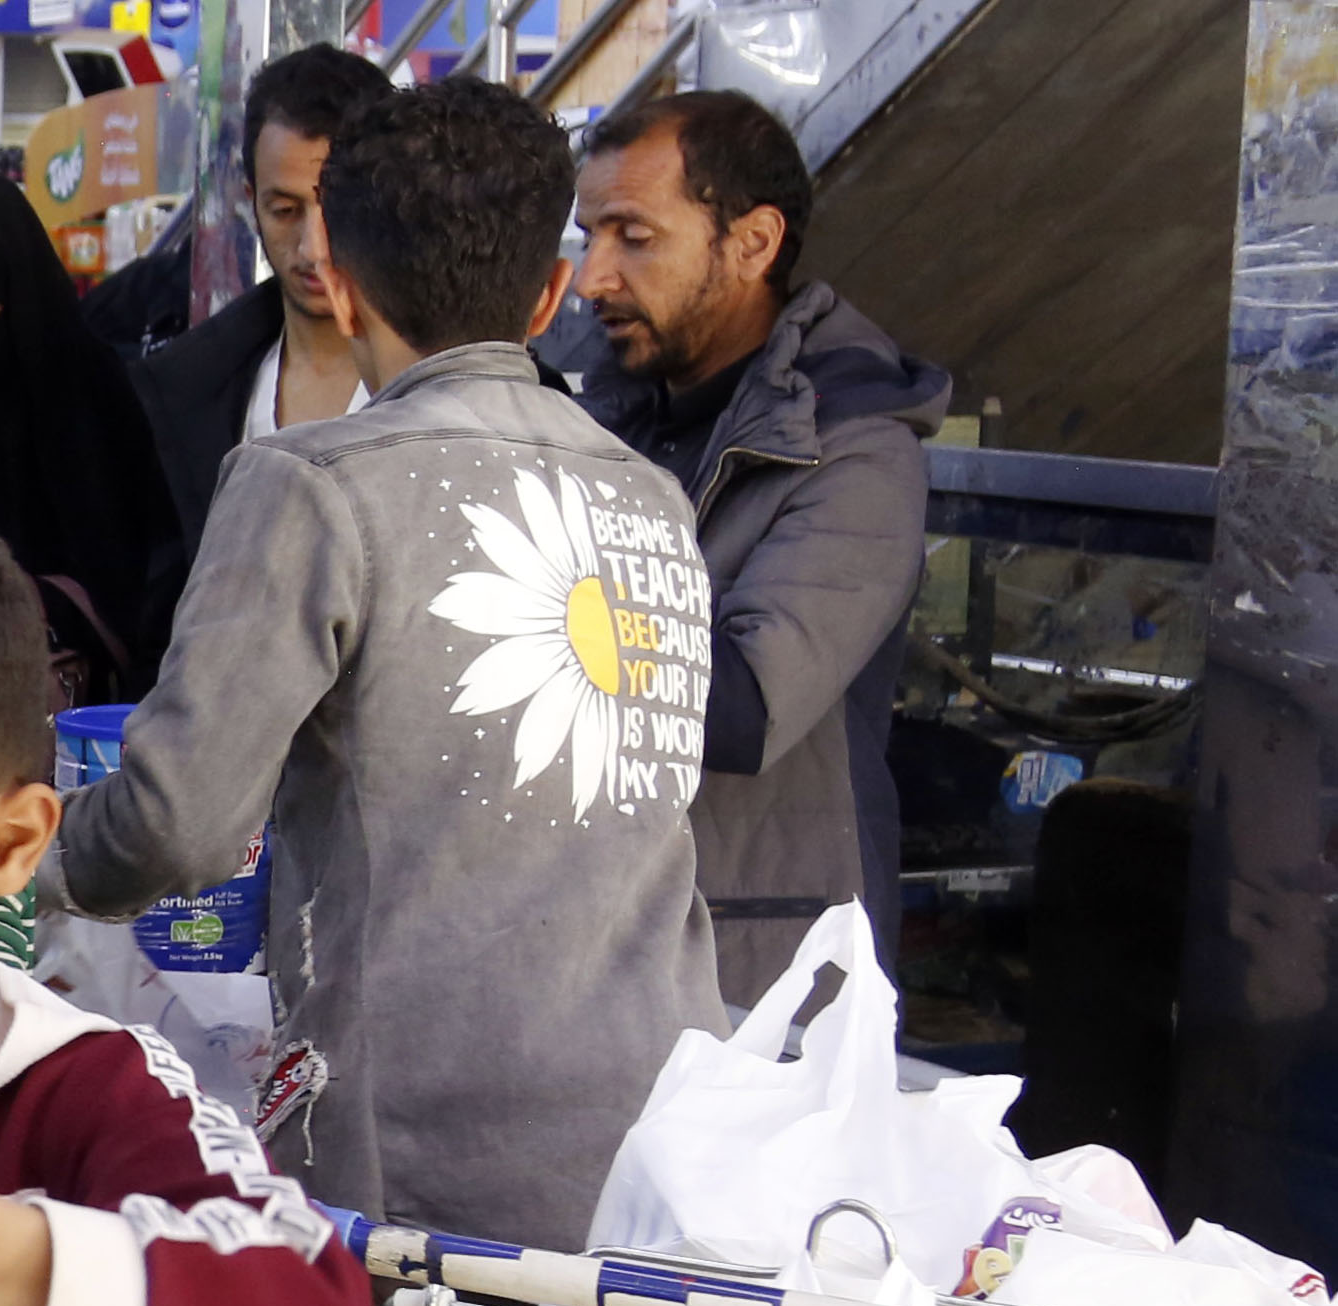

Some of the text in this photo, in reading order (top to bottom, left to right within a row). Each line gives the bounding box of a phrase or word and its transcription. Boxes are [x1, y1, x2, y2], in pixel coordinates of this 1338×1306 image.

[589, 505, 697, 561] BECAME A
[601, 549, 712, 626] TEACHE
[613, 607, 712, 671] BECAUS
[623, 660, 688, 708] YOUR
[623, 706, 643, 748] IS
[619, 755, 658, 800] MY
